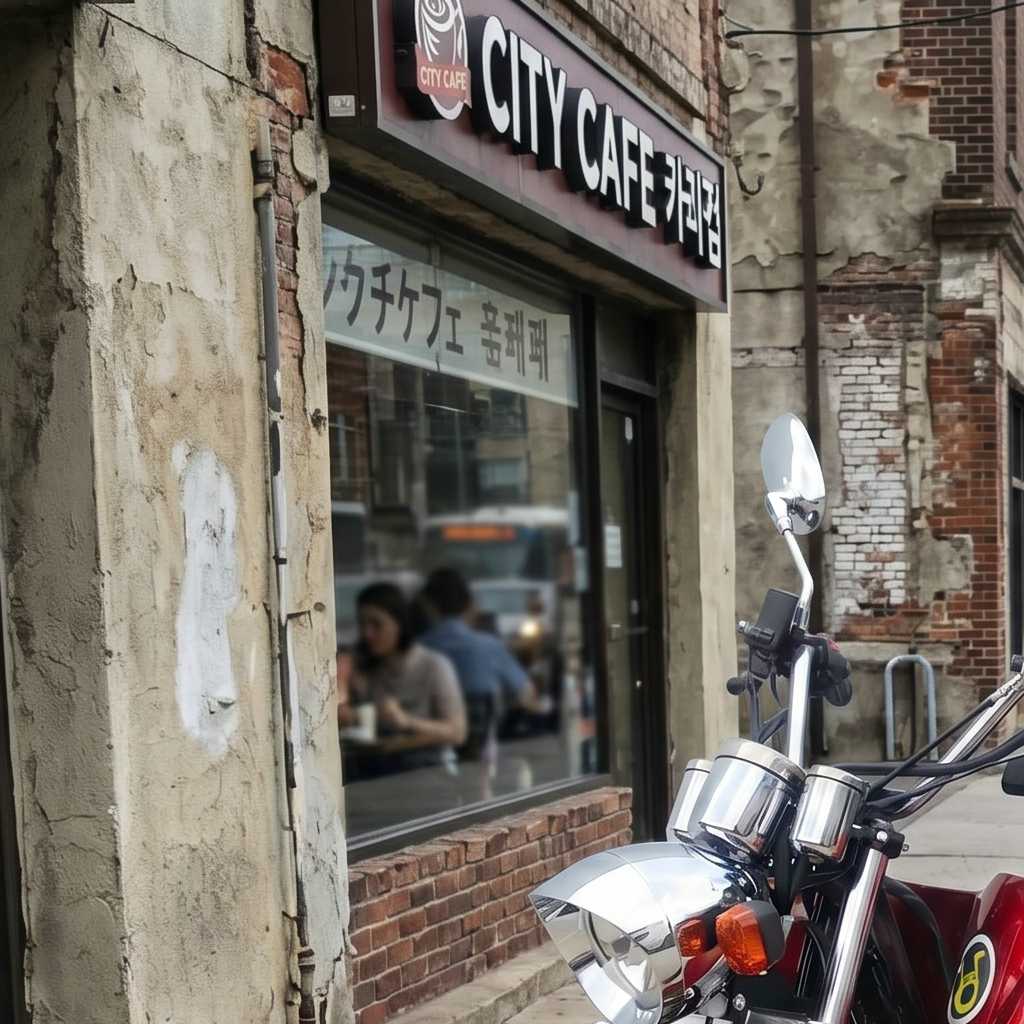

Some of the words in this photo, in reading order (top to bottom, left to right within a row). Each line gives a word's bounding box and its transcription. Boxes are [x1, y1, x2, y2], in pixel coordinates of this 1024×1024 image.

[420, 66, 441, 88] CITY
[443, 69, 466, 90] CAFE
[482, 16, 567, 170] CITY
[577, 88, 656, 228] CAFE
